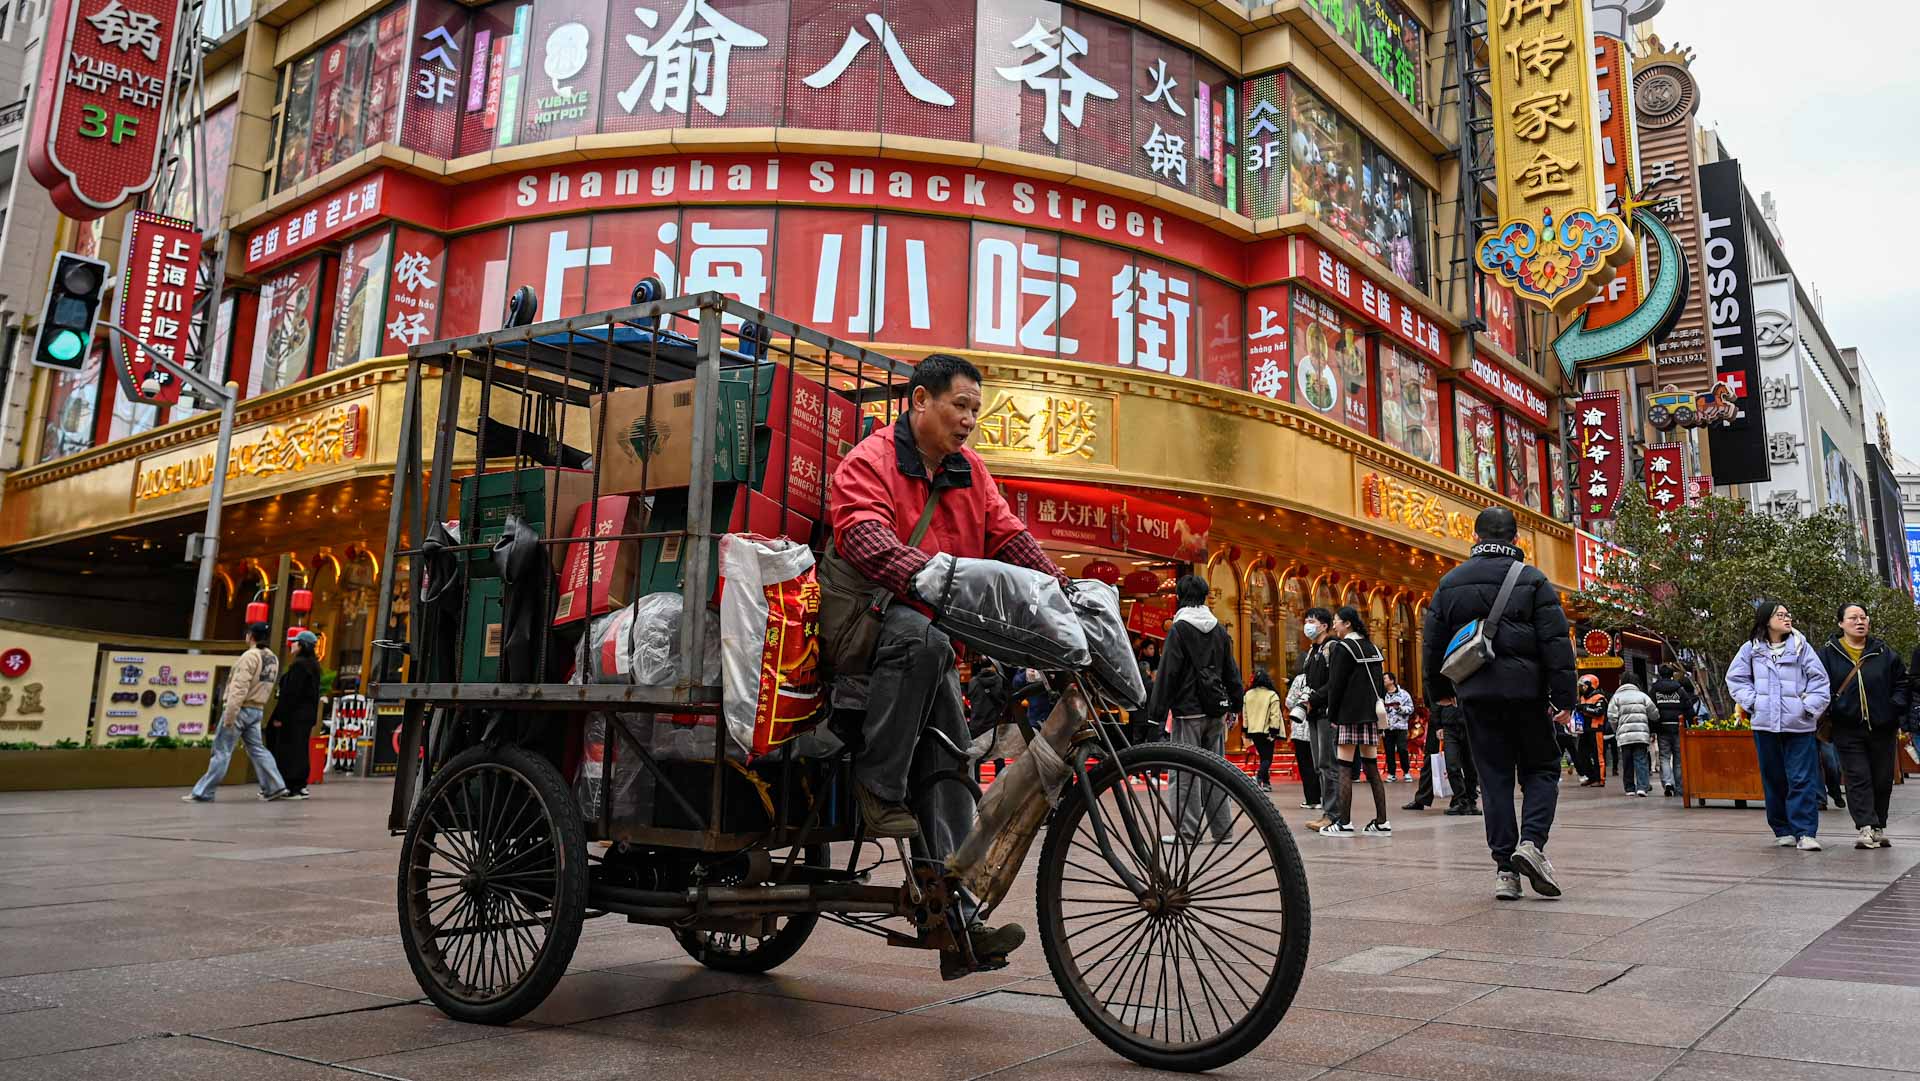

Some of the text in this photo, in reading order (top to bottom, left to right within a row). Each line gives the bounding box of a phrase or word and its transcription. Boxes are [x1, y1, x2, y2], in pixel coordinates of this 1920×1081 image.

[86, 0, 163, 61] 锅
[66, 69, 162, 109] HOT POT
[71, 51, 164, 95] YUBAYE
[416, 69, 457, 105] 3F
[617, 0, 1119, 145] 渝八爷
[537, 91, 588, 109] YUBAYE
[79, 103, 140, 145] 3F
[1144, 58, 1188, 186] 火锅
[1247, 141, 1280, 171] 3F
[325, 182, 379, 229] 老上海
[516, 159, 1165, 246] Shanghai Snack Street
[535, 222, 1191, 378] 上海小吃街
[1318, 250, 1350, 299] 老街
[1400, 305, 1440, 355] 老上海
[1704, 212, 1745, 368] TISSOT
[386, 311, 430, 347] 好
[1247, 305, 1285, 340] 上
[1250, 357, 1288, 398] 海
[1685, 353, 1703, 361] 1921
[795, 388, 842, 427] 农夫山泉
[1471, 359, 1548, 417] anghai Snack Street
[793, 407, 817, 426] NONGFU
[977, 390, 1097, 460] 金楼
[1582, 407, 1614, 497] 渝八爷火锅
[789, 474, 814, 493] NONGFU
[1038, 499, 1108, 529] 盛大开业
[1471, 543, 1517, 557] ESCENTE
